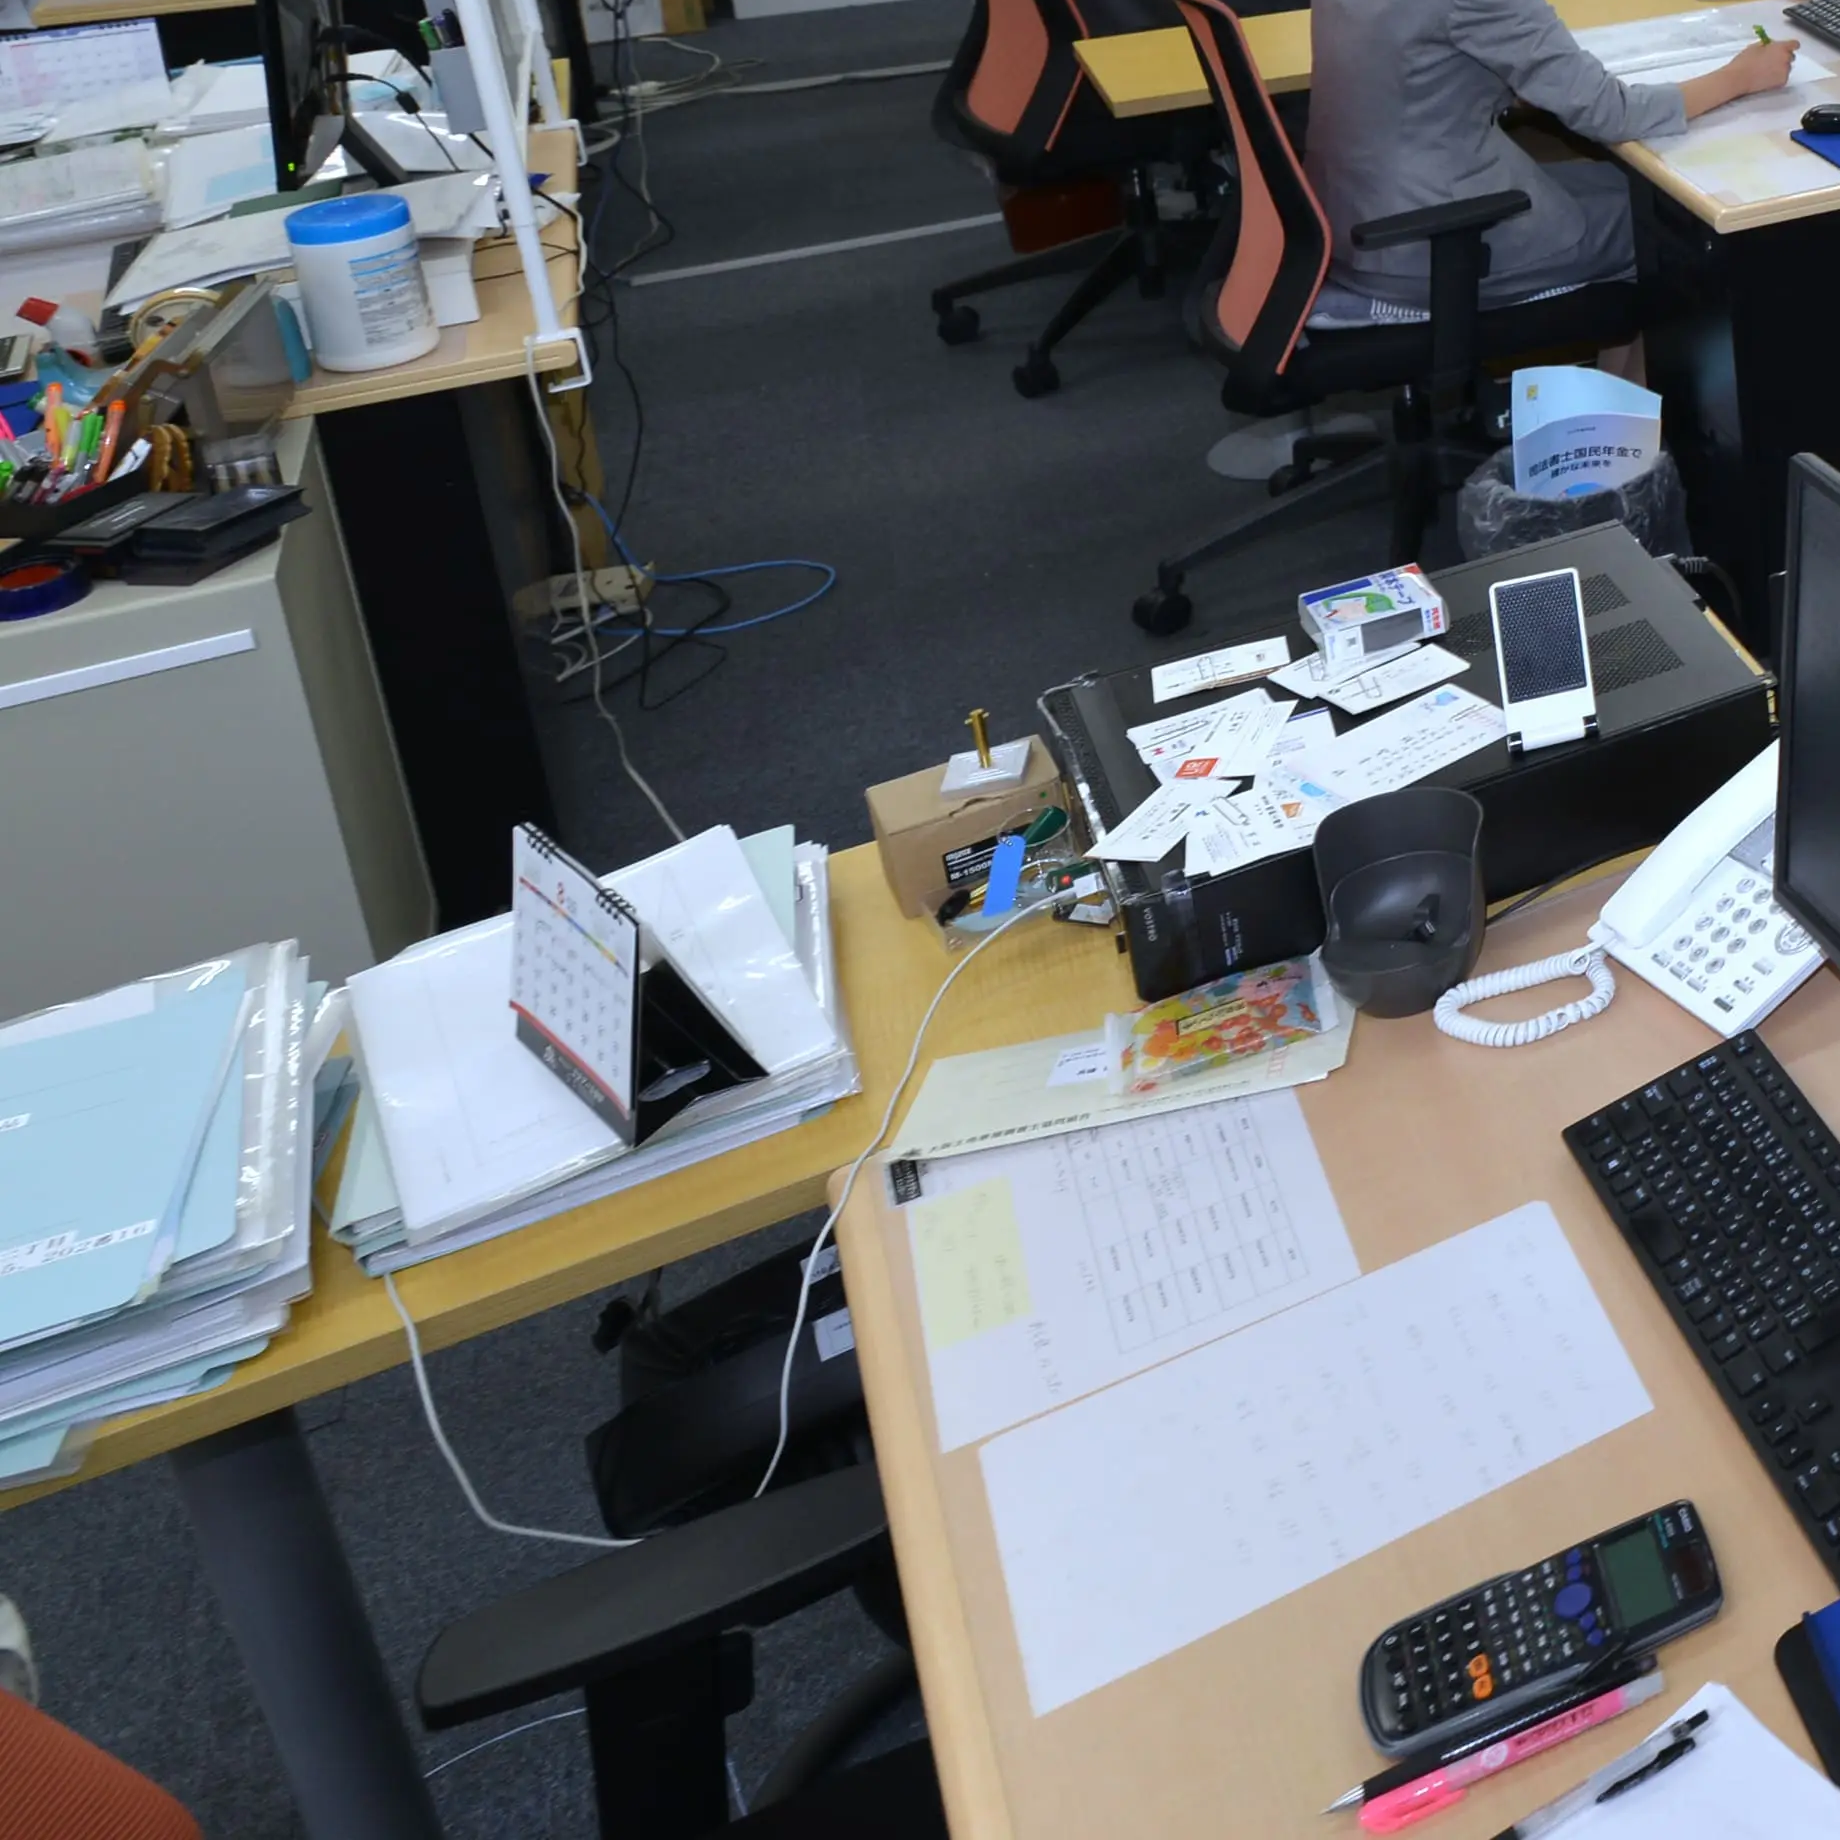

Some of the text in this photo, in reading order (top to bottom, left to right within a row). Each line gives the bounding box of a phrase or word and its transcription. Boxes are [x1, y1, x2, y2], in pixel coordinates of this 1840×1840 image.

[1528, 445, 1643, 478] 司法書士国民年金で
